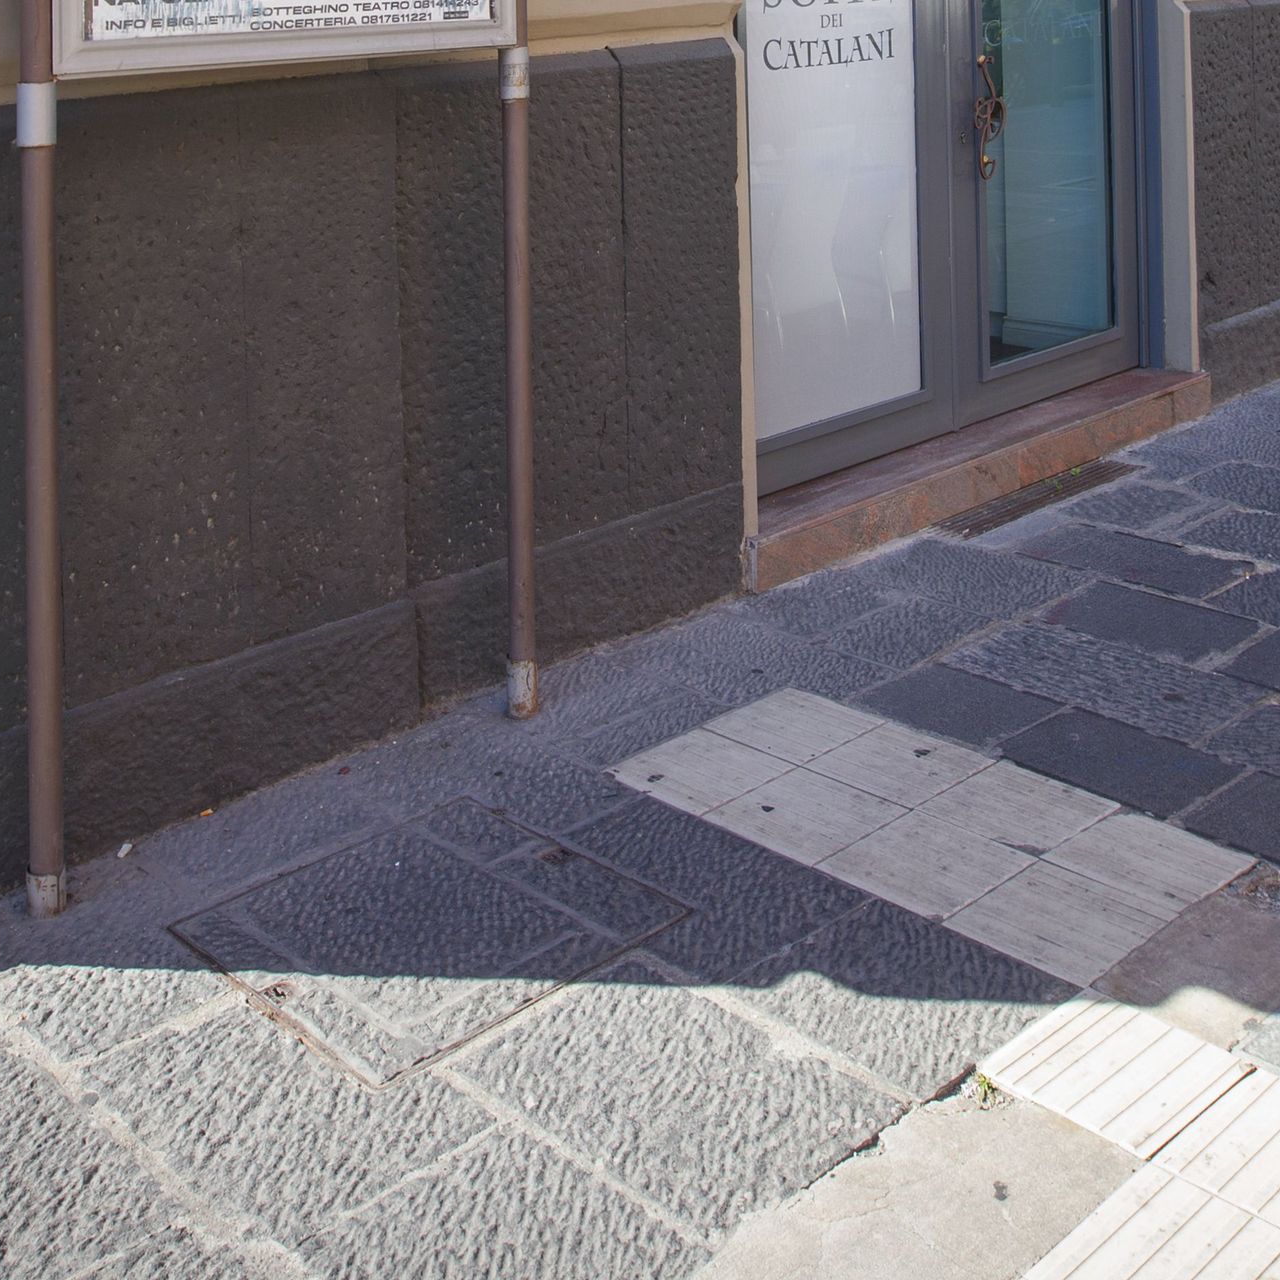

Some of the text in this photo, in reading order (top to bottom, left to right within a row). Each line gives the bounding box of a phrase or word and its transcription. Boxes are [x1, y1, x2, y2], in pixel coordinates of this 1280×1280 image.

[252, 4, 348, 17] BOTTEGHINO
[354, 1, 409, 13] TEATRO
[105, 18, 146, 30] INFO
[151, 18, 162, 28] E
[249, 17, 357, 30] CONCERTERIA
[820, 13, 843, 28] DEI
[763, 28, 895, 70] CATALANI
